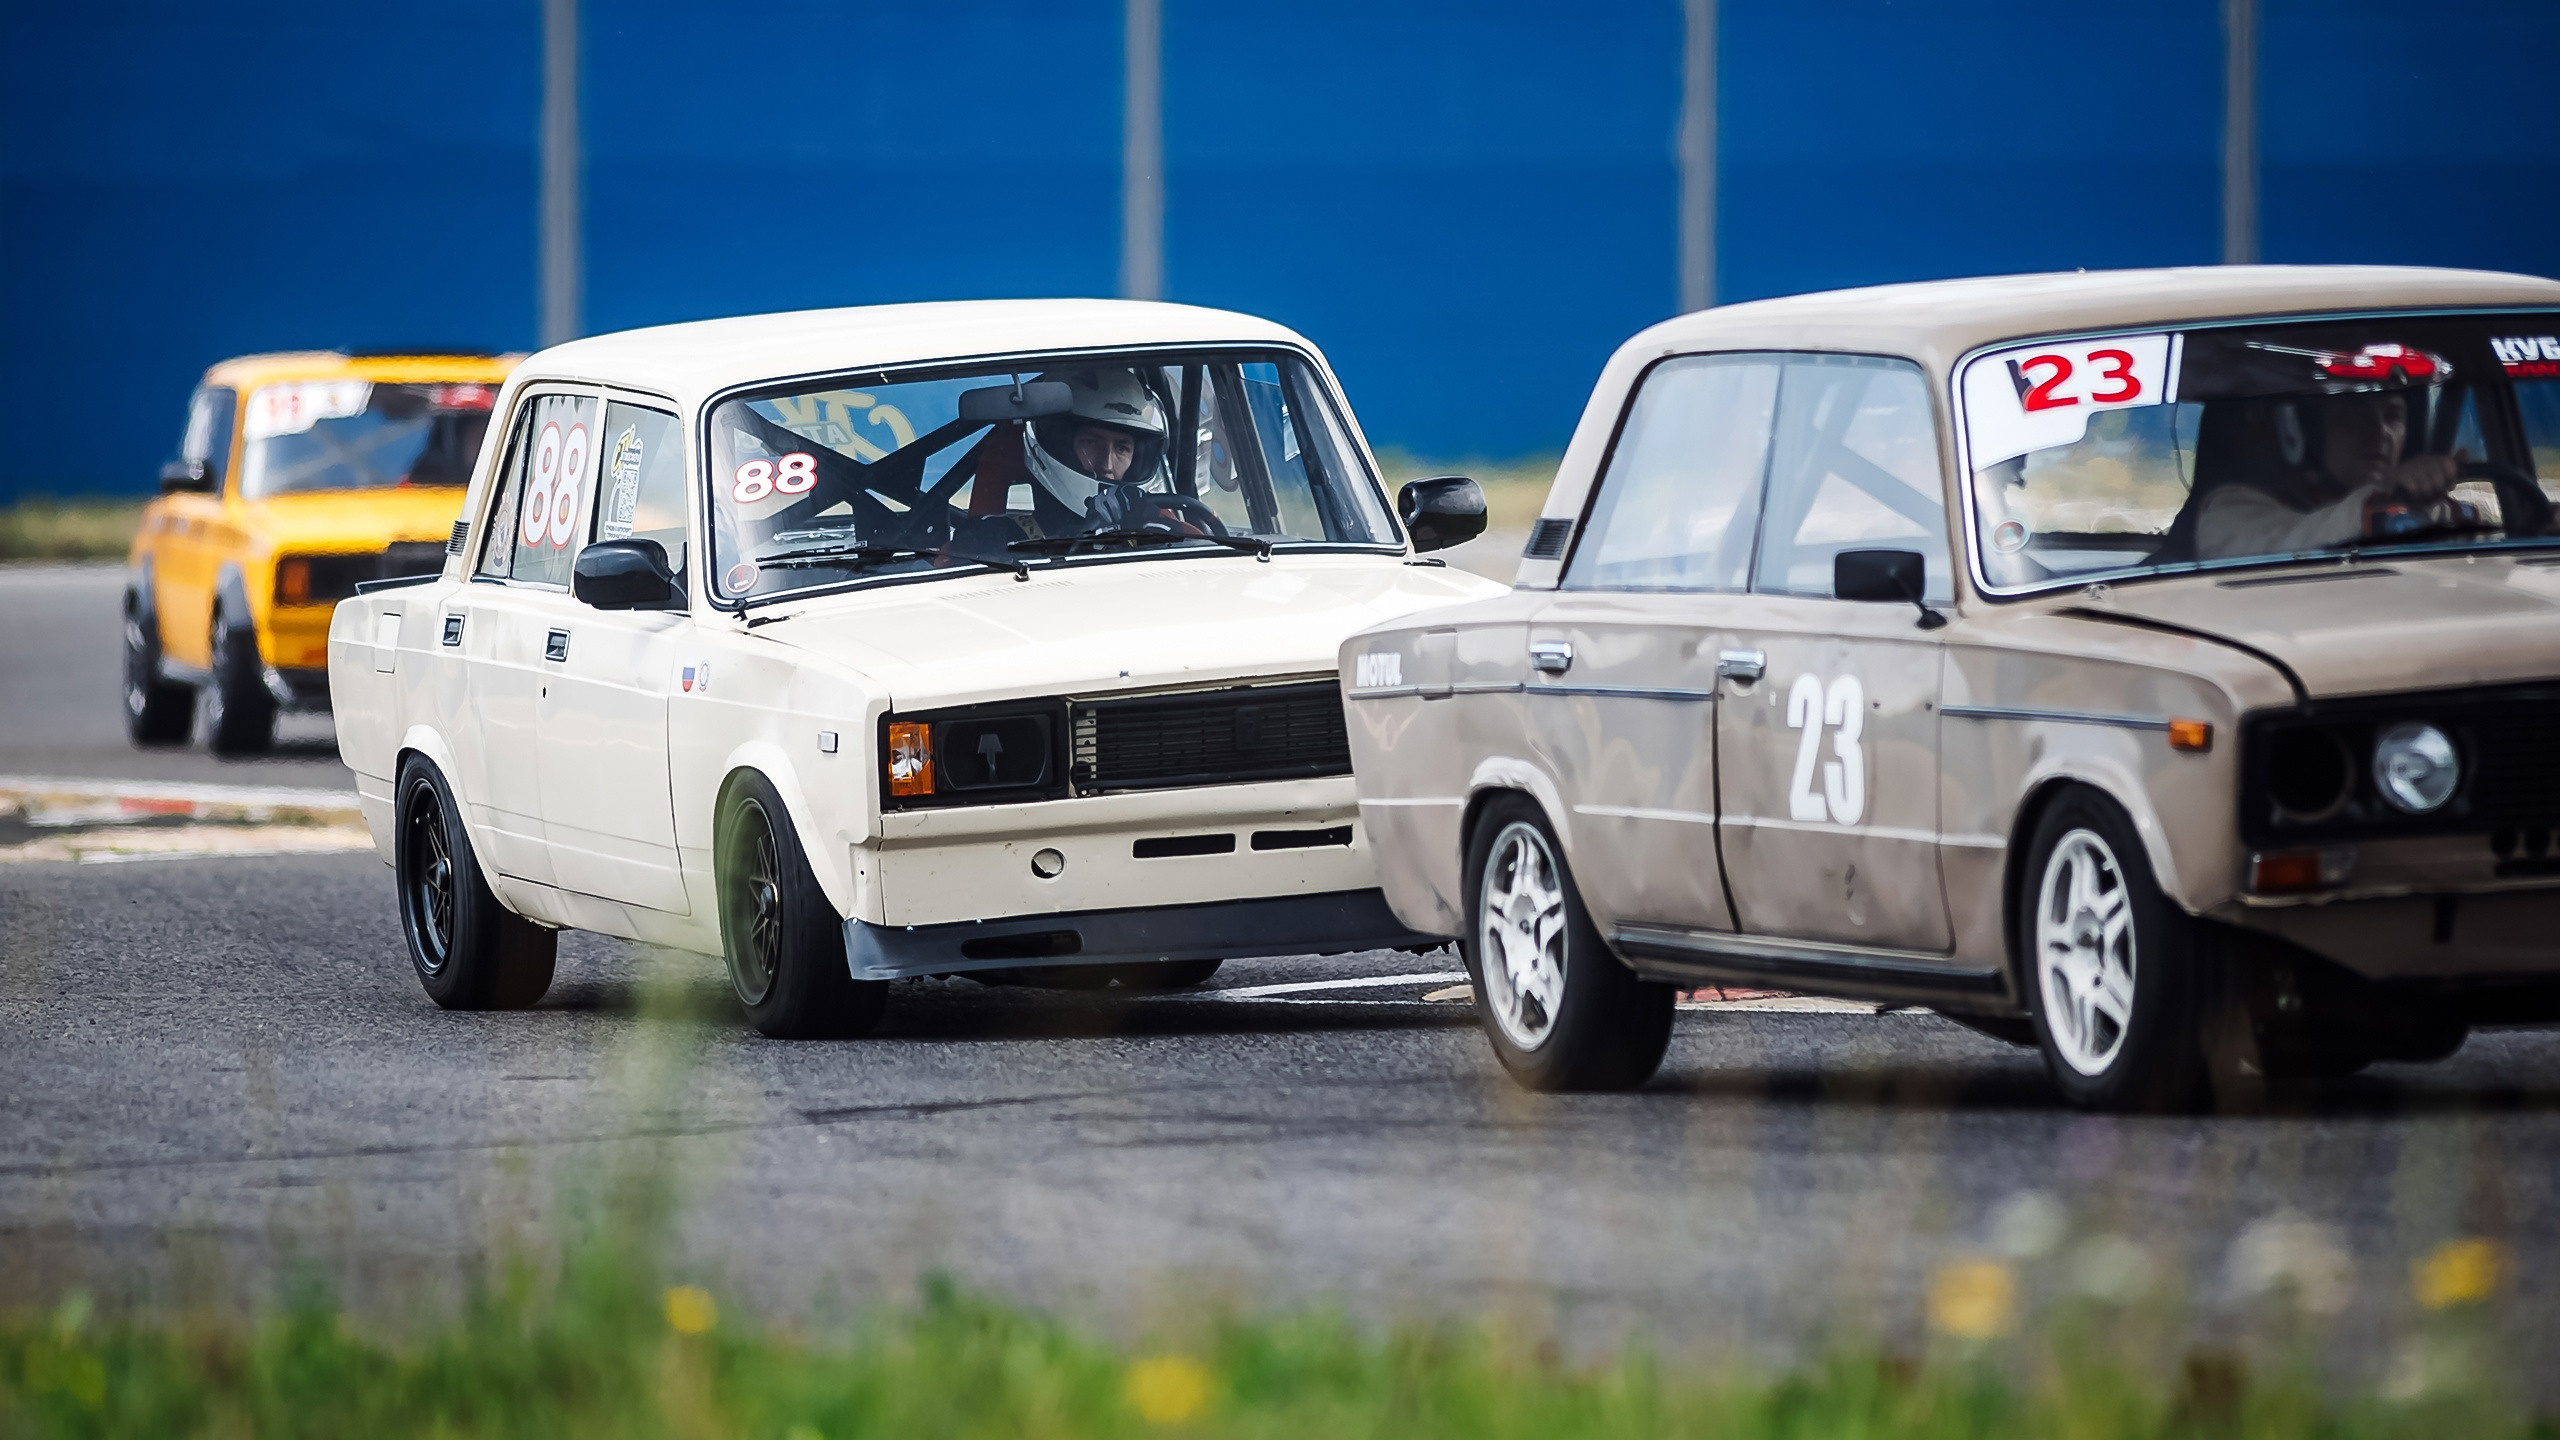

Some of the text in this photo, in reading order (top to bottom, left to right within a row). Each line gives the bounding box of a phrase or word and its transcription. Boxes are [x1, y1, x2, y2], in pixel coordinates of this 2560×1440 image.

[2022, 349, 2141, 412] 23
[523, 421, 589, 550] 88
[732, 452, 818, 504] 88
[1787, 673, 1864, 826] 23
